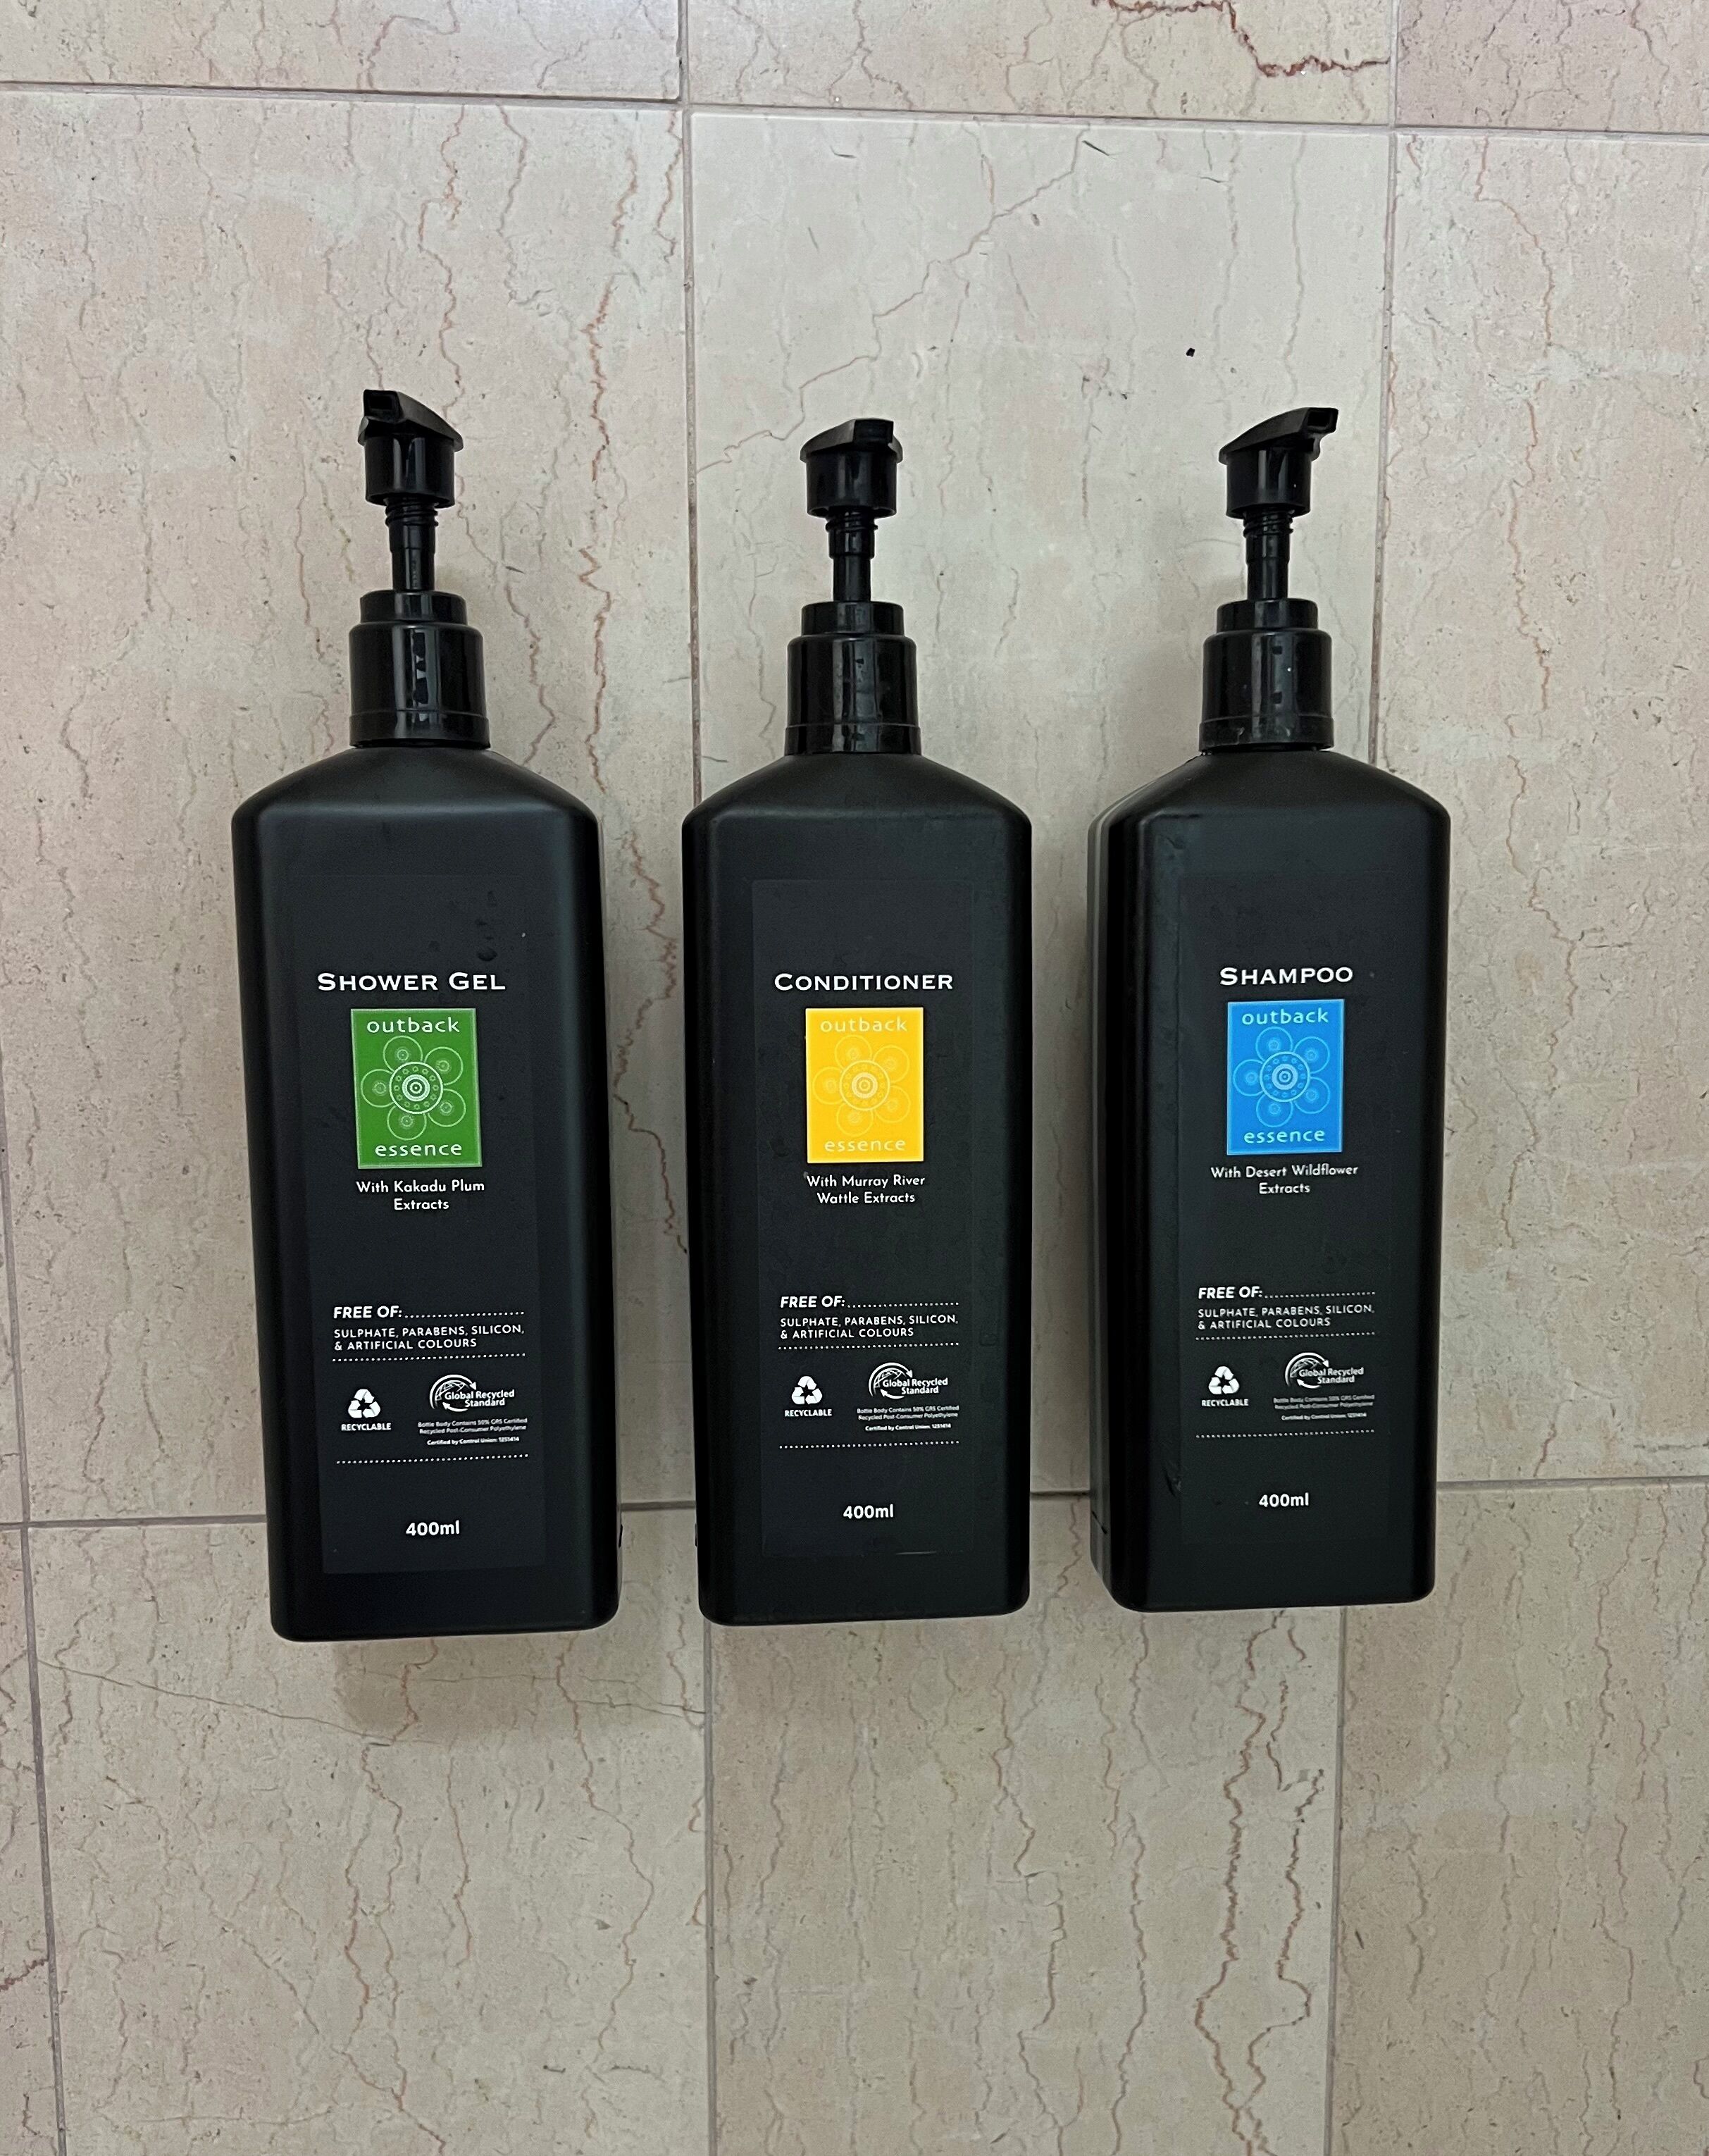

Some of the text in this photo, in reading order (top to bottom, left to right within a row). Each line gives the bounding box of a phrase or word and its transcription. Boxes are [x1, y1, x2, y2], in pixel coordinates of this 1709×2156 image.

[1242, 1008, 1329, 1025] outback
[366, 1017, 460, 1033] outback
[820, 1017, 907, 1033] outback
[1243, 1129, 1326, 1144] essence
[375, 1143, 462, 1157] essence
[824, 1138, 906, 1152] essence
[1210, 1163, 1359, 1179] With Desert Wildflower
[356, 1179, 485, 1193] With Kakadu Plum
[806, 1175, 925, 1189] With Murray River
[1259, 1182, 1310, 1194] Extracts
[817, 1191, 916, 1203] Wattle Extracts
[394, 1198, 449, 1210] Extracts
[1198, 1287, 1235, 1299] FREE
[780, 1296, 817, 1308] FREE
[333, 1306, 373, 1319] FREE
[1198, 1304, 1375, 1318] SULPHATE, PARABENS, SILICON,
[780, 1314, 959, 1327] SULPHATE, PARABENS, SILICON,
[1198, 1318, 1331, 1330] & ARTIFICIAL COLOURS
[334, 1324, 525, 1339] SULPHATE, PARABENS, SILICON,
[780, 1327, 914, 1339] & ARTIFICIAL COLOURS
[334, 1339, 477, 1351] & ARTIFICIAL COLOURS
[1298, 1367, 1364, 1377] Global Recycled
[882, 1377, 948, 1388] Global Recycled
[1317, 1375, 1355, 1384] Standard
[445, 1389, 515, 1400] Global Recycled
[901, 1386, 939, 1395] Standard
[465, 1398, 505, 1408] Standard
[1201, 1399, 1249, 1407] RECYCLABLE
[784, 1408, 833, 1417] RECYCLABLE
[341, 1423, 392, 1431] RECYCLABLE
[1258, 1492, 1310, 1508] 400ml
[843, 1504, 894, 1519] 400ml
[406, 1520, 460, 1537] 400ml
